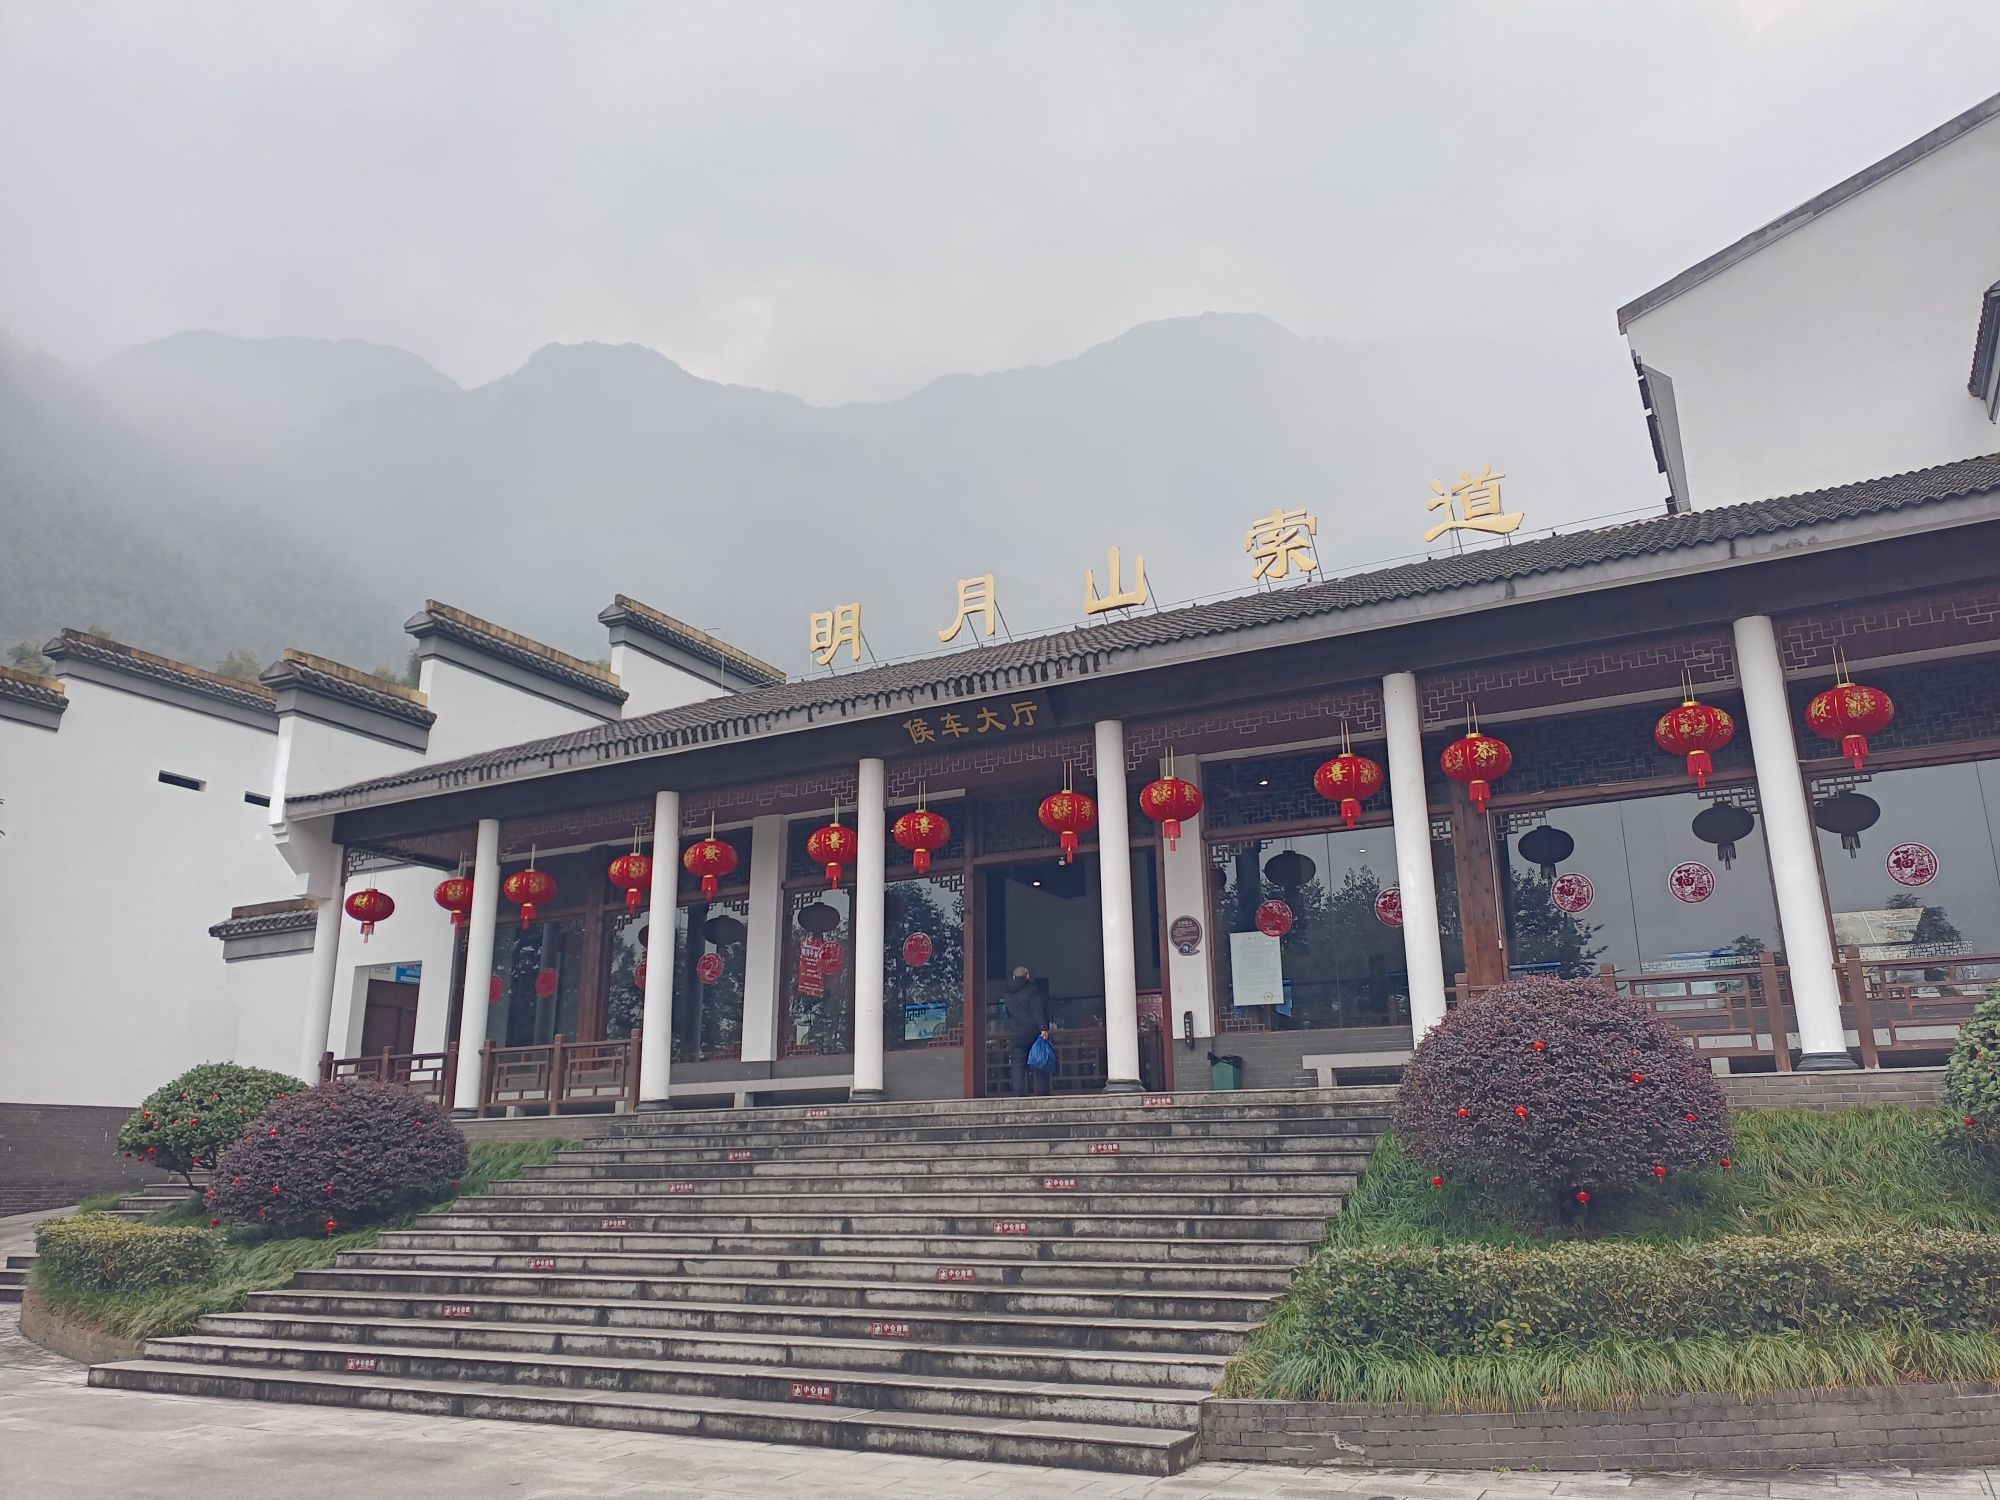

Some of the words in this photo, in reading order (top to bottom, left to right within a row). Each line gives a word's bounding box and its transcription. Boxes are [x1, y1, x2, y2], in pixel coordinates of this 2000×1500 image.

[810, 464, 1524, 666] 明月山索道
[903, 701, 1037, 744] 候车大厅
[883, 1323, 909, 1332] 小心台阶
[803, 1384, 830, 1395] 小心台阶
